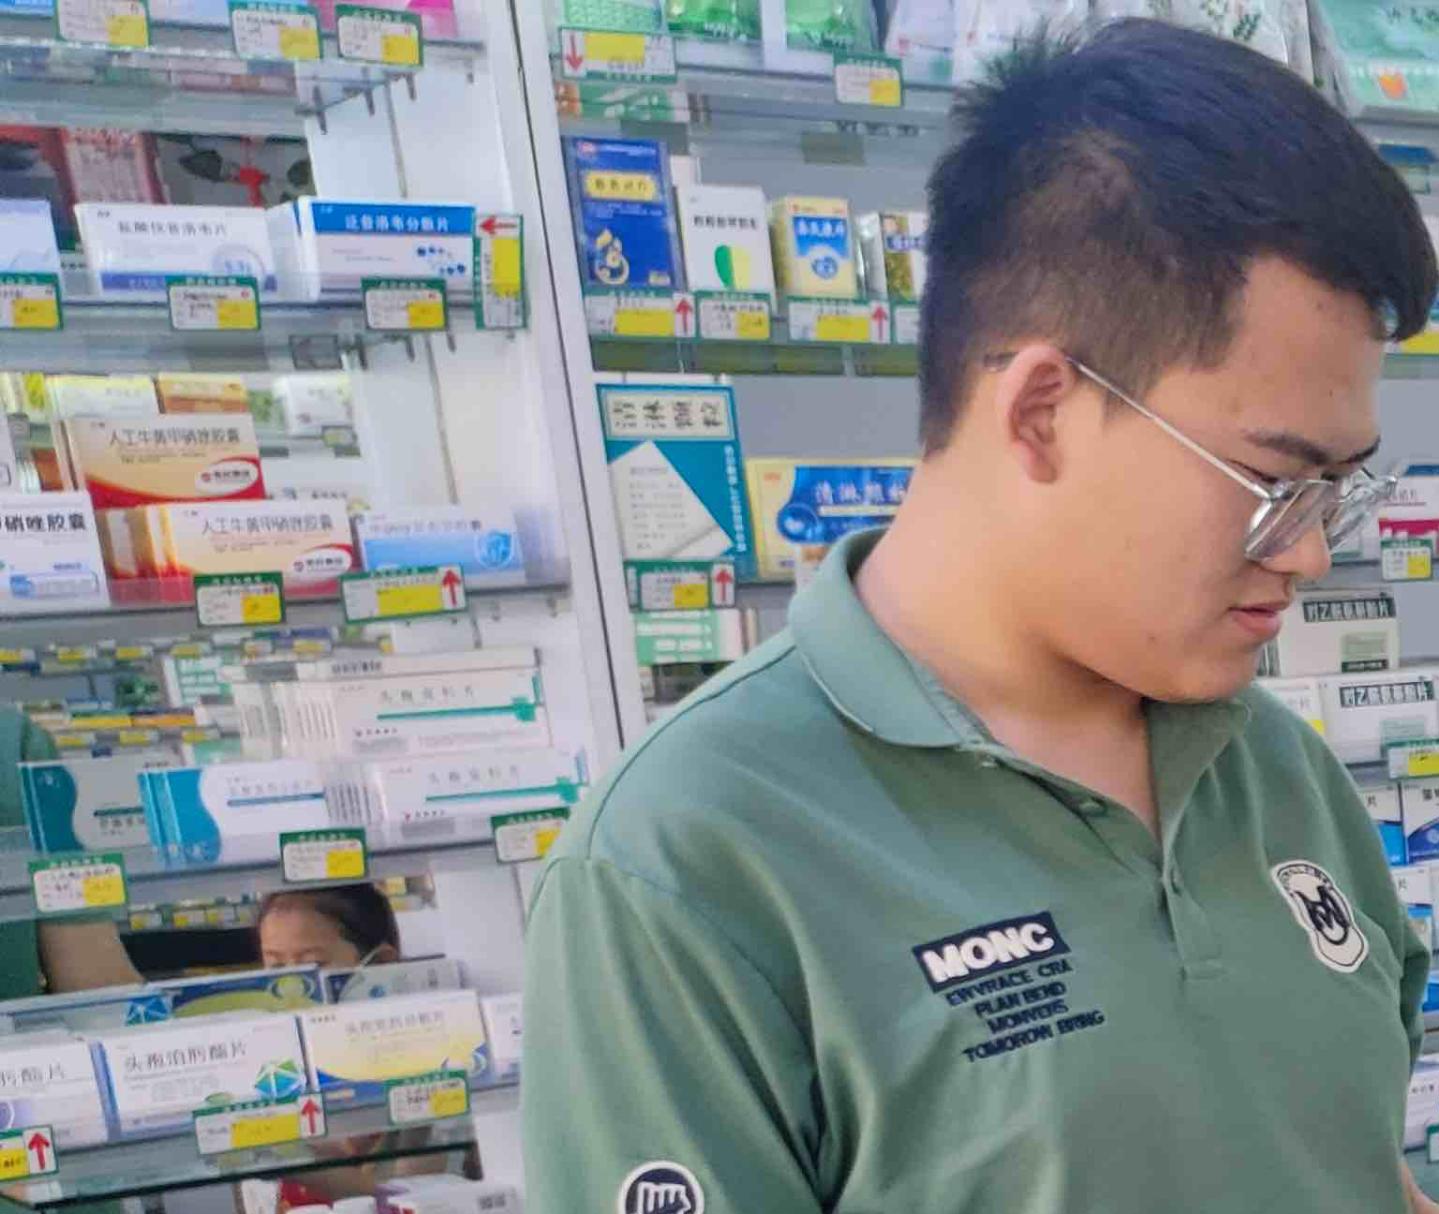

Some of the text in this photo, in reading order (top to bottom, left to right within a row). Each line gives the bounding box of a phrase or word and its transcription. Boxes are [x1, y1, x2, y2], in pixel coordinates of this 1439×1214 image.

[0, 510, 87, 534] 硝唑胶囊
[922, 922, 1054, 983] MONC
